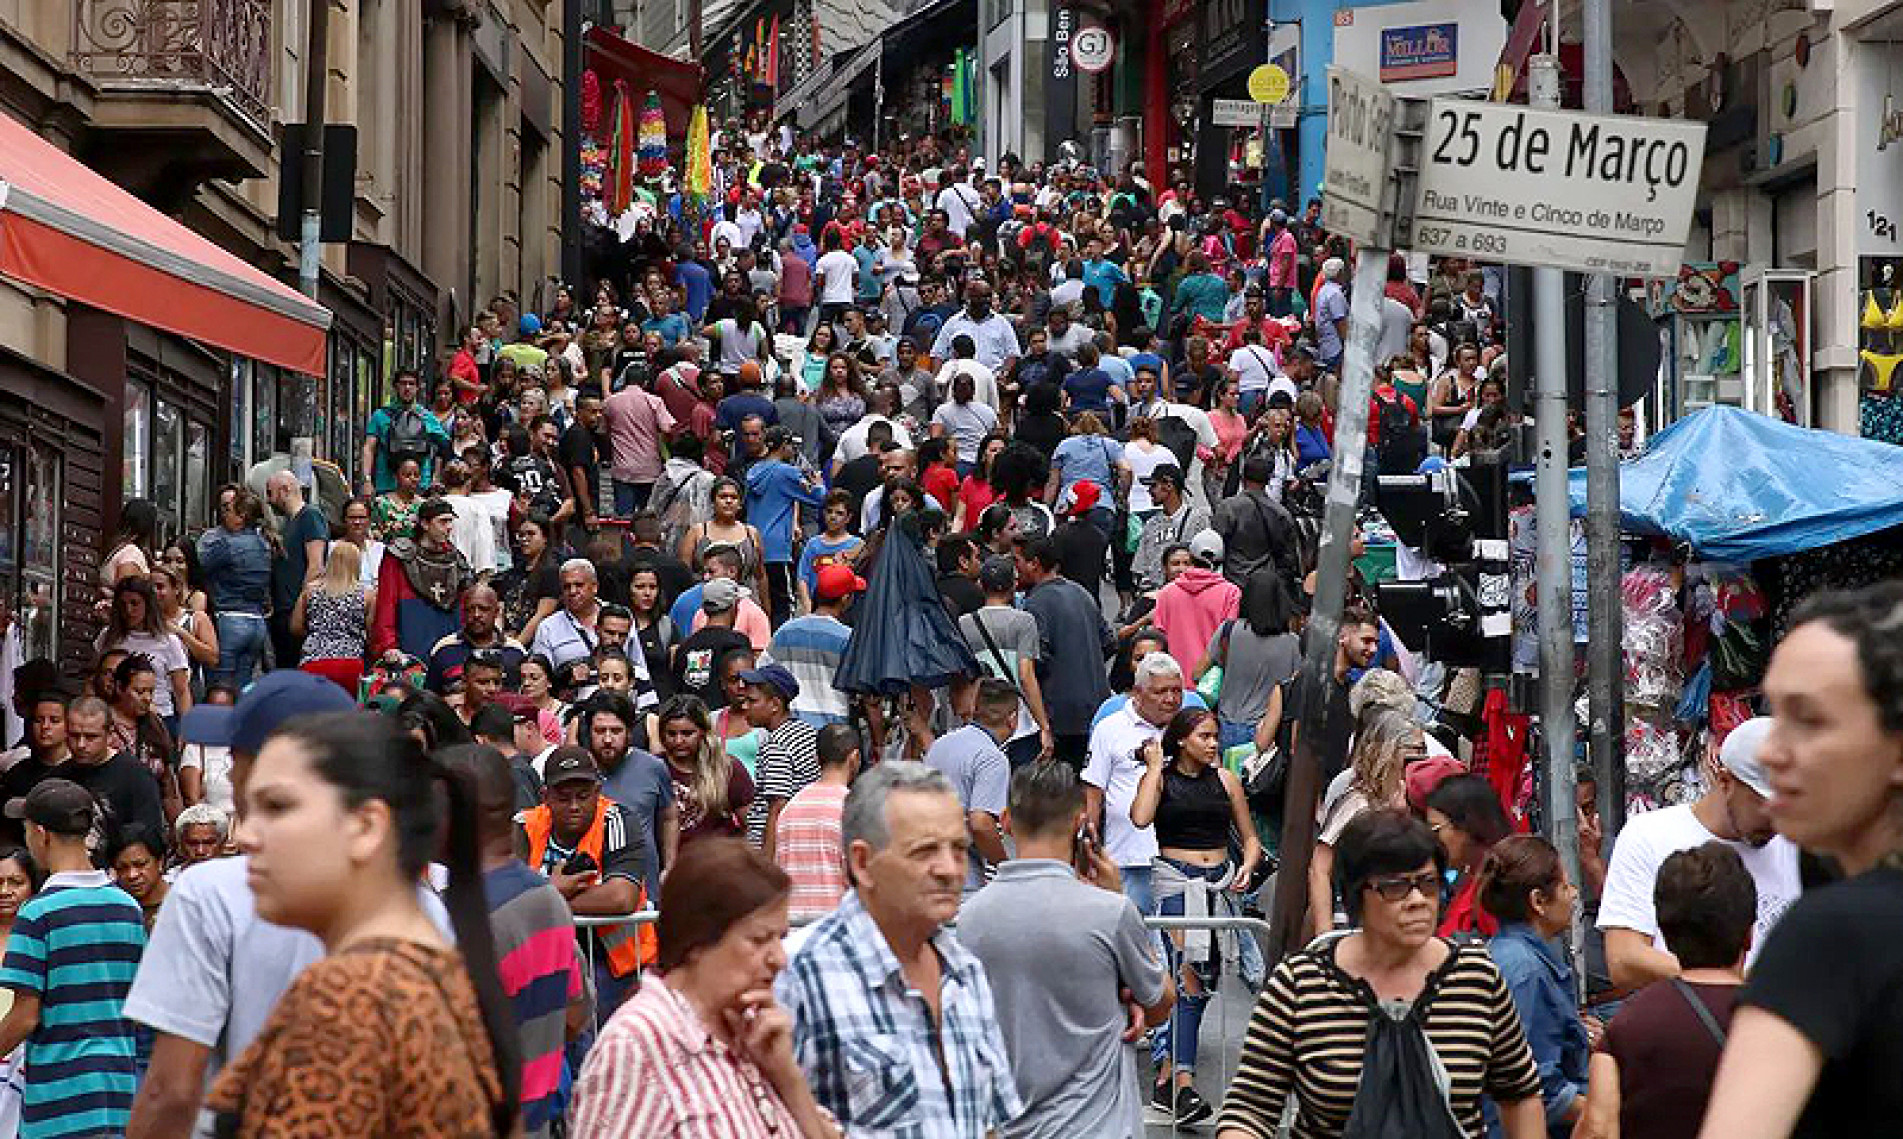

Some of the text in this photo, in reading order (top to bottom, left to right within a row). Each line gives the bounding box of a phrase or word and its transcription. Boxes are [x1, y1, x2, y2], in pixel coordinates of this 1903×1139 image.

[1432, 109, 1688, 202] 25 de Março
[1422, 189, 1665, 236] Rua Vinte e Cinco de Março
[1866, 209, 1896, 243] 121
[1417, 226, 1507, 252] 637 a 693
